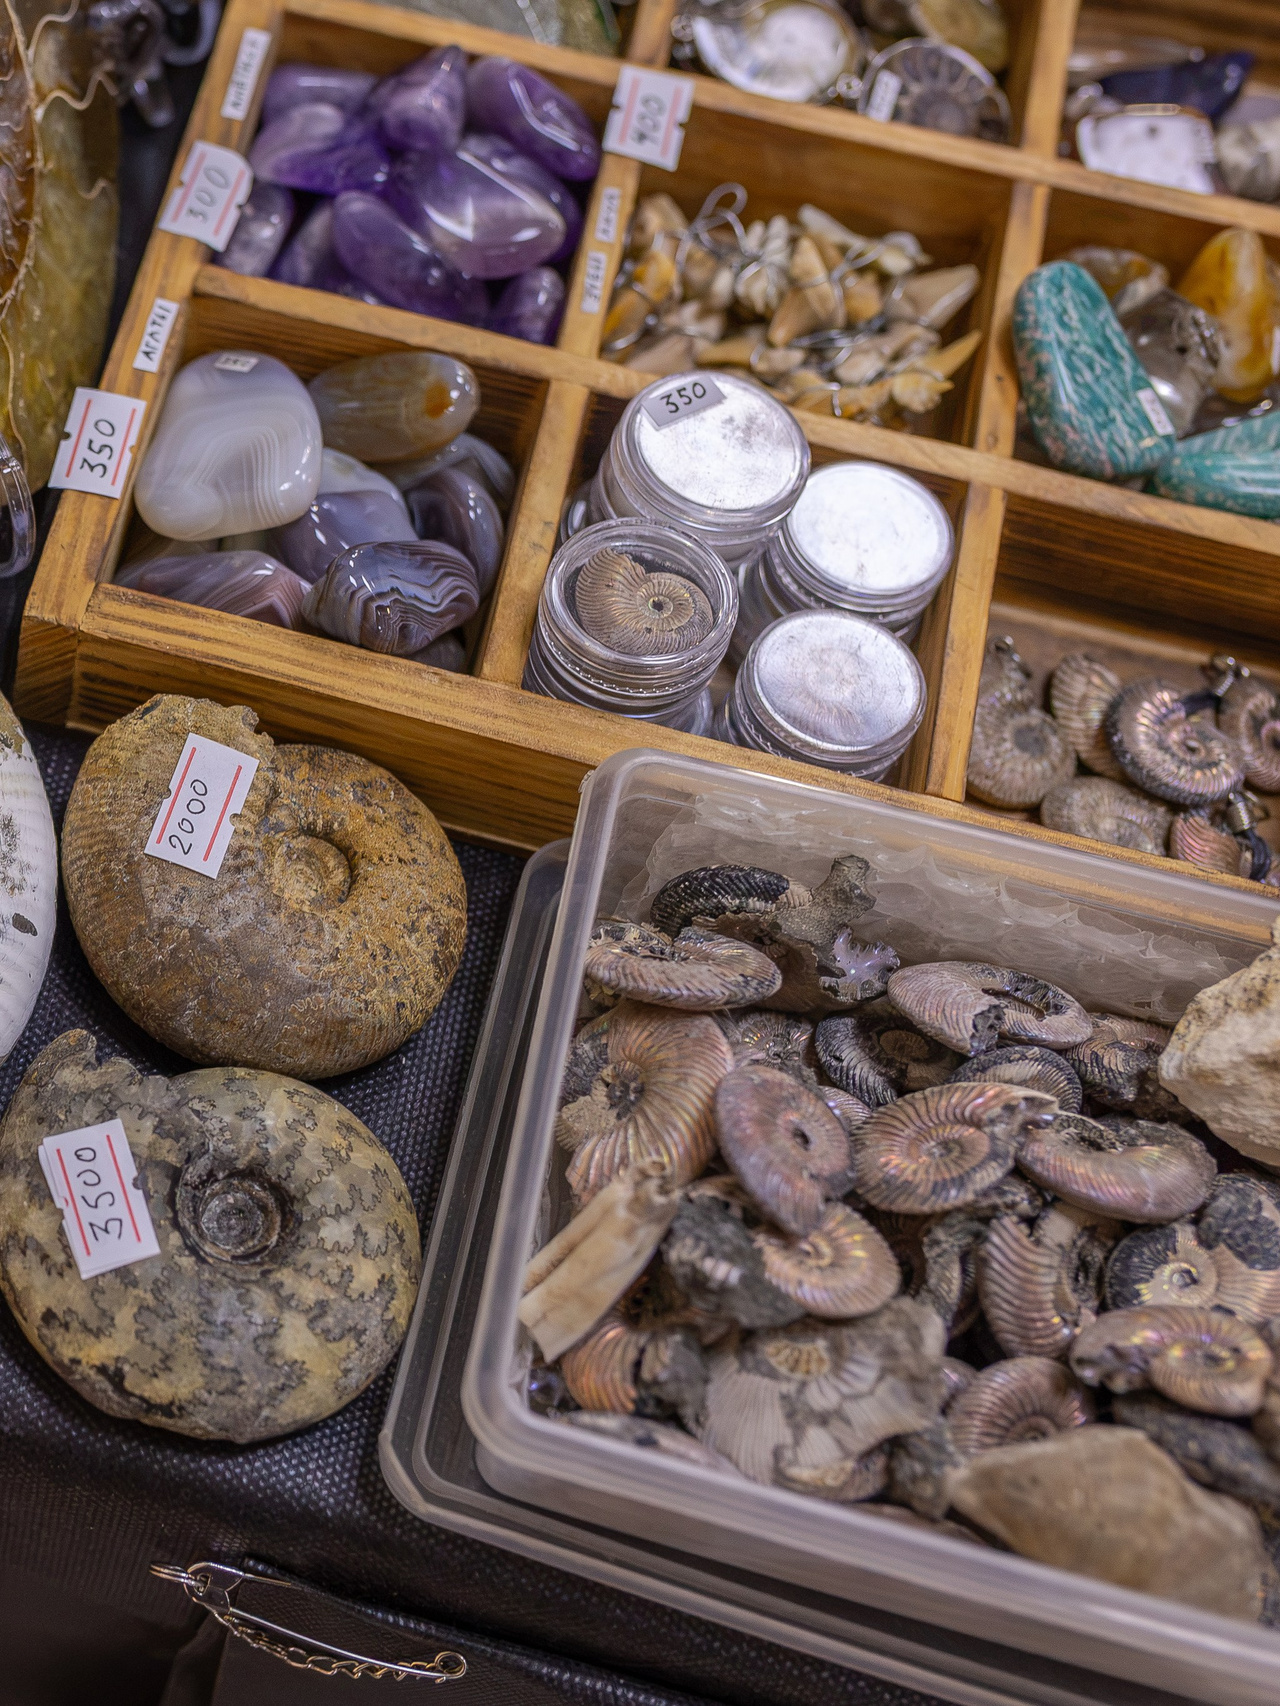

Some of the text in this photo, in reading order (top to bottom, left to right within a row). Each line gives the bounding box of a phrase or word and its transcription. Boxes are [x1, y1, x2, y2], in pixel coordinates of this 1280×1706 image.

[631, 94, 666, 147] 400
[186, 165, 231, 224] 300
[660, 382, 706, 414] 350
[79, 418, 115, 478] 350
[168, 779, 208, 856] 2000
[74, 1147, 123, 1242] 3500
